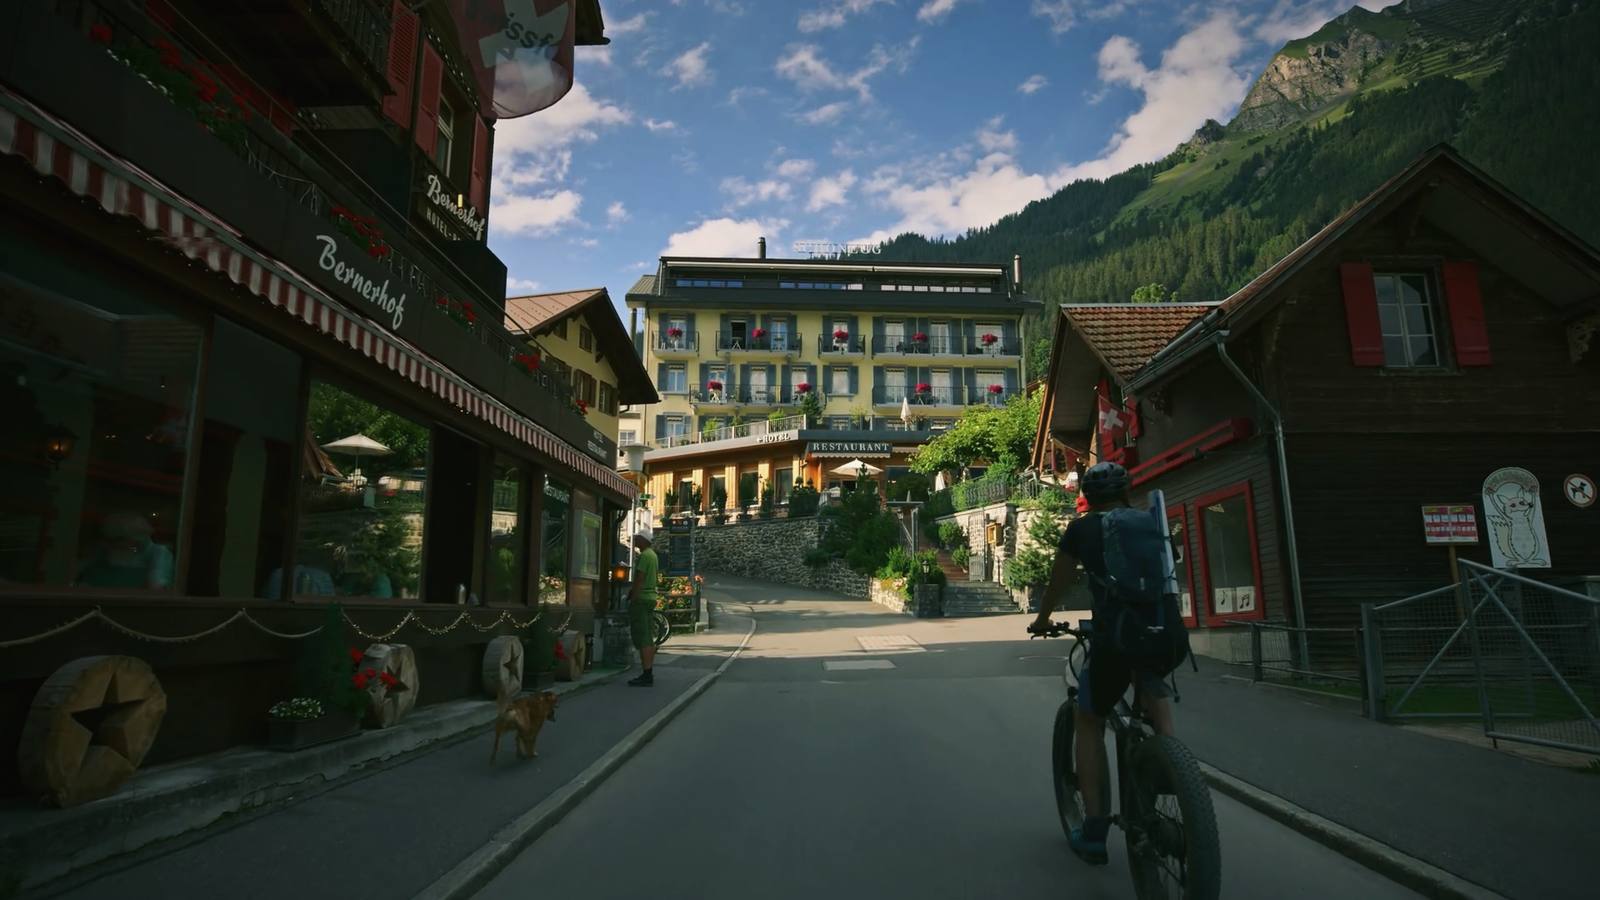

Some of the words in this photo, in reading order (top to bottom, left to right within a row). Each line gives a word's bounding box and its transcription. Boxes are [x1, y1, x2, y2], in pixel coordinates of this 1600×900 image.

[426, 174, 486, 241] Bernerhof
[316, 234, 406, 330] Bernerhof
[813, 442, 889, 451] RESTAURANT
